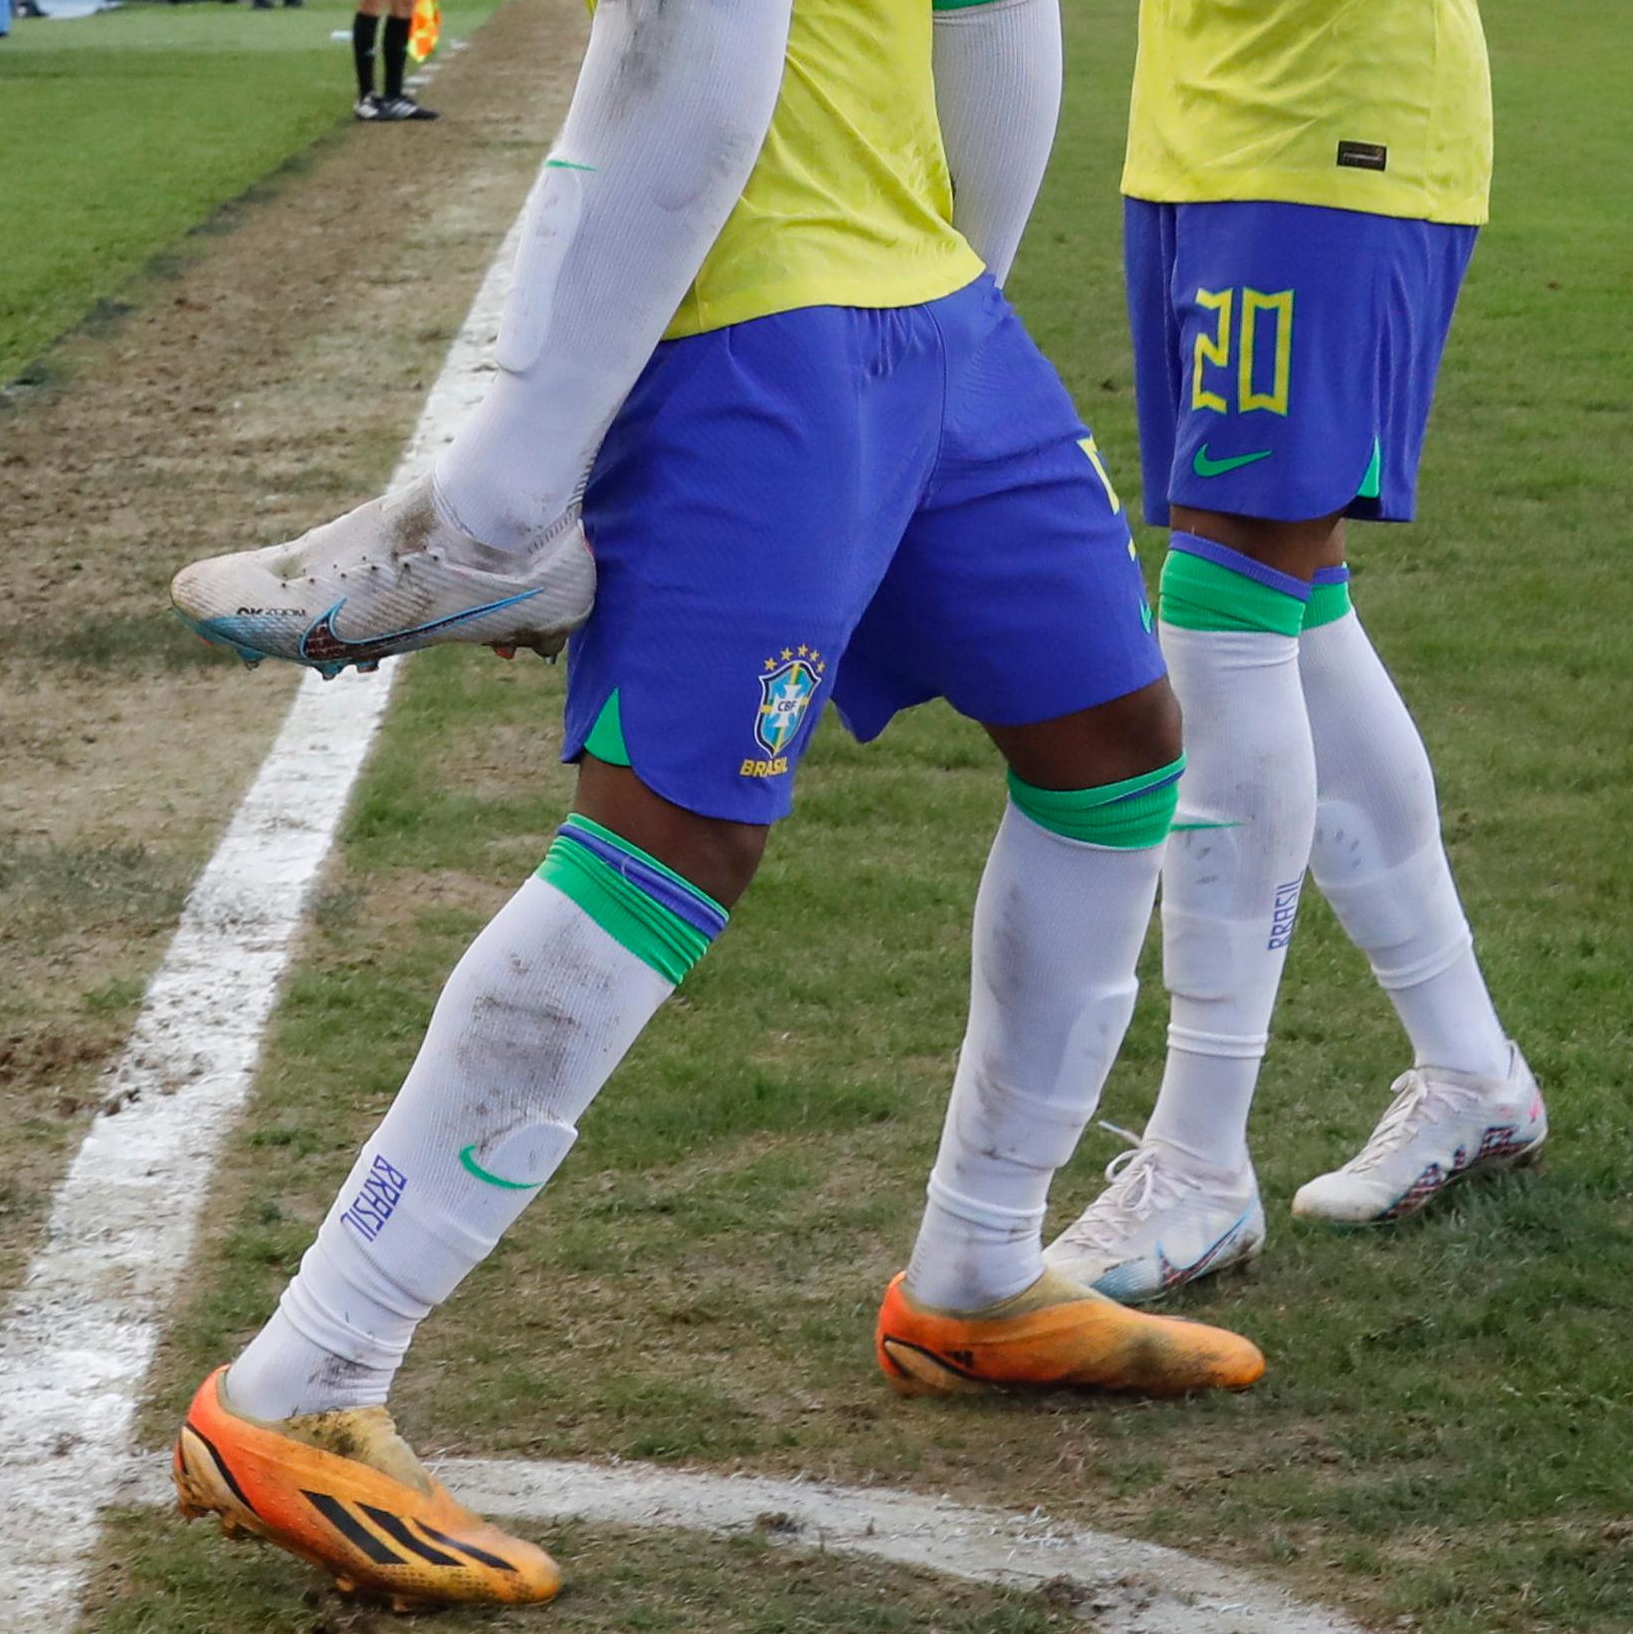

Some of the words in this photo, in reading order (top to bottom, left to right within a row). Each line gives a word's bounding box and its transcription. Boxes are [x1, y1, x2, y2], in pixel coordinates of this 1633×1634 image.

[1191, 286, 1295, 418] 20
[777, 699, 798, 713] CBF
[739, 755, 788, 778] BRASIL
[340, 1153, 408, 1242] BRASIL
